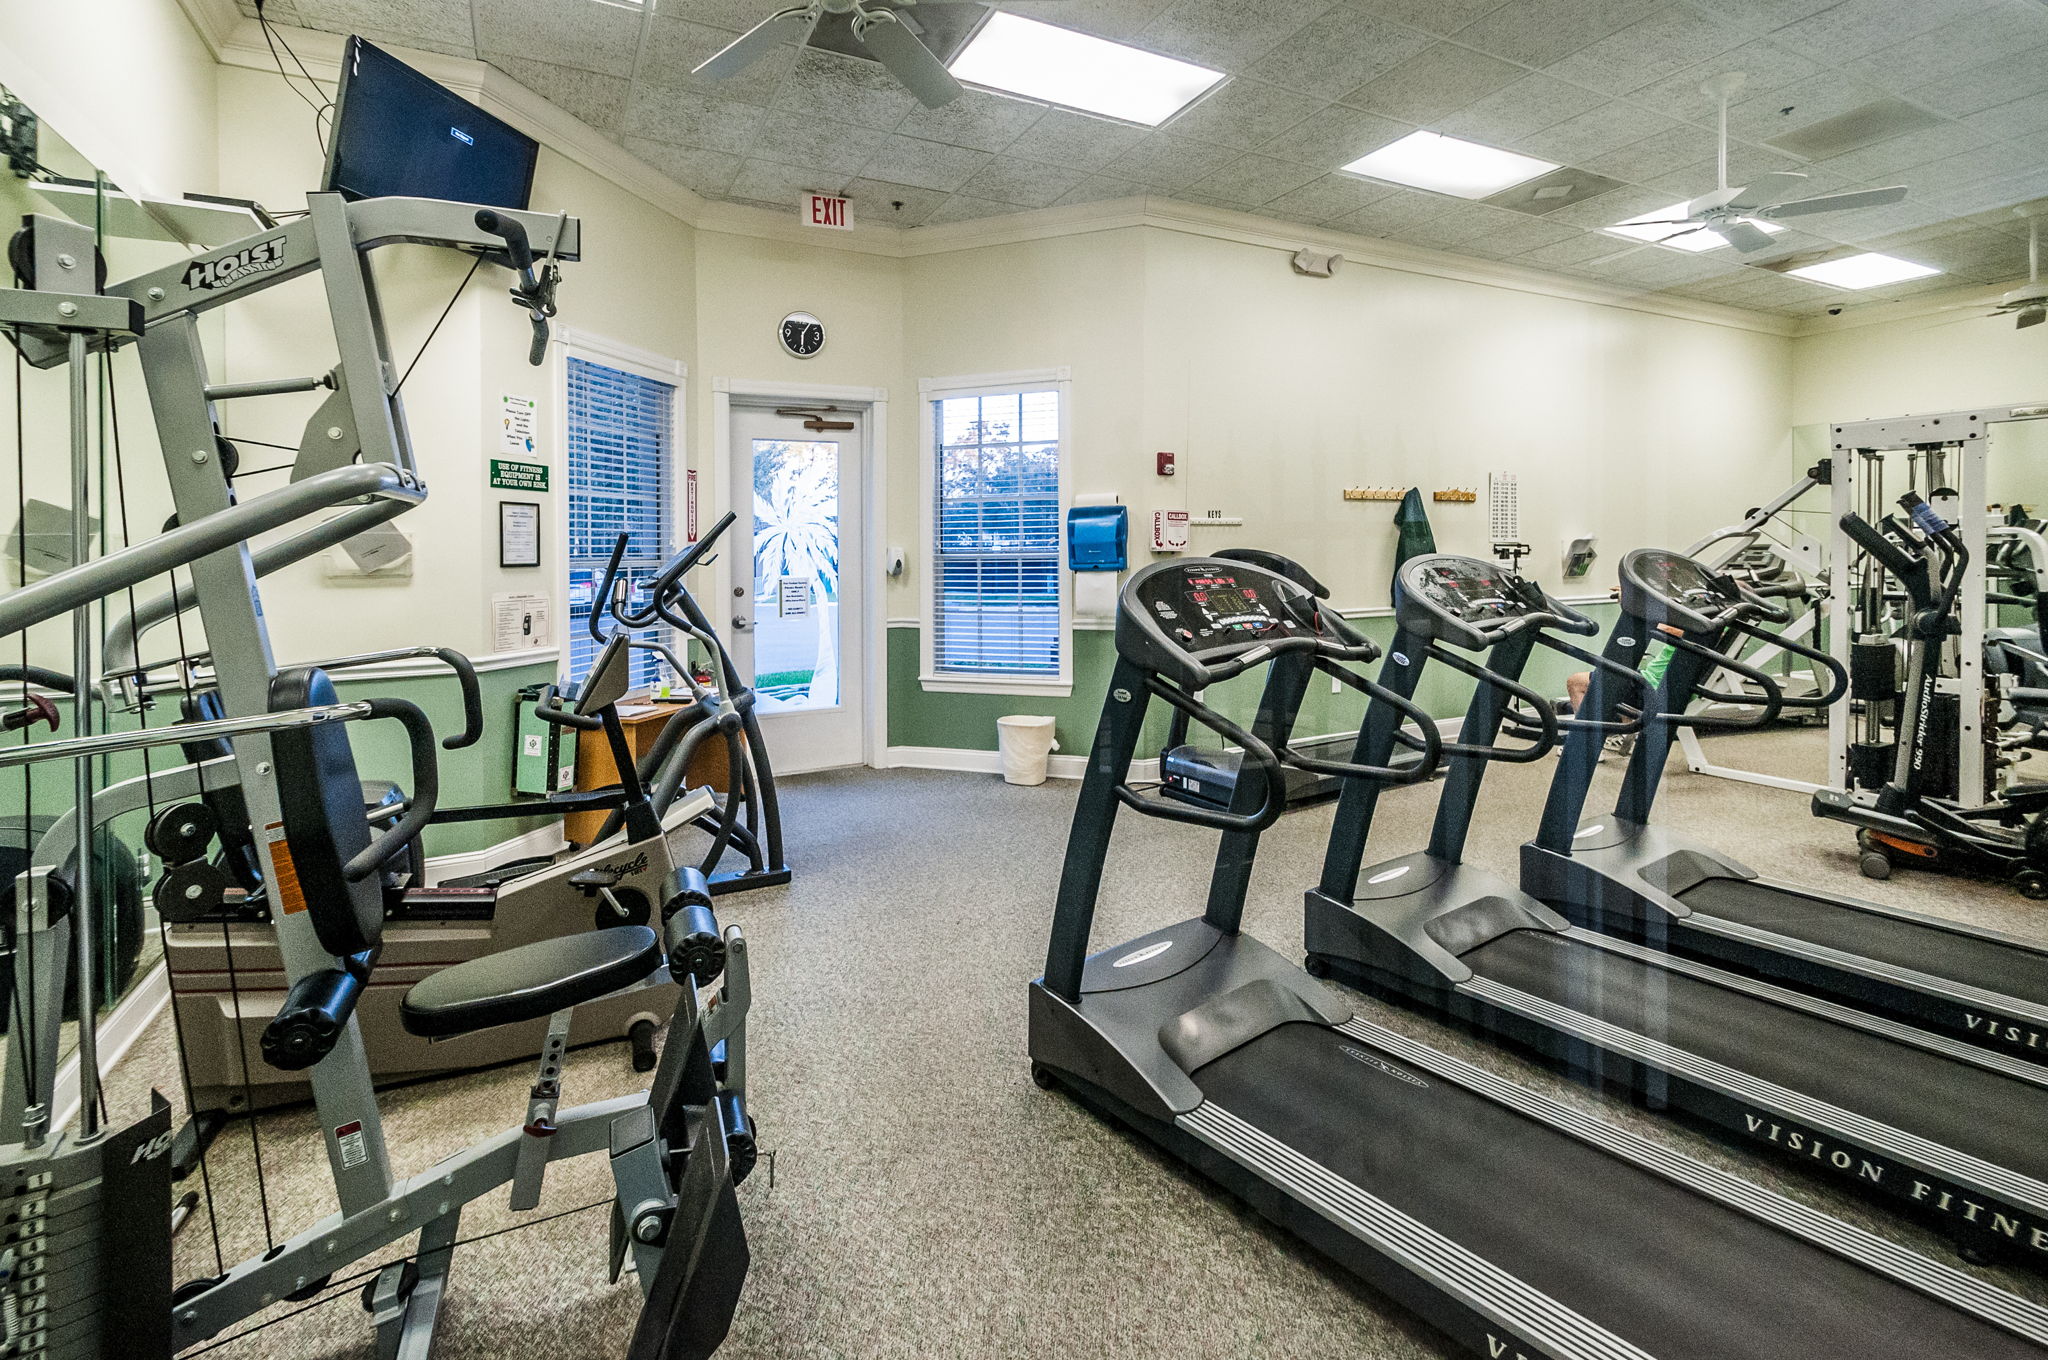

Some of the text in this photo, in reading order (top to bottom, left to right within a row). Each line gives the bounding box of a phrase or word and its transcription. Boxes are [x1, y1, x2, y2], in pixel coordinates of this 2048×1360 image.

[812, 196, 846, 226] EXIT
[189, 235, 287, 290] HOIST
[784, 328, 792, 338] 9
[813, 331, 820, 341] 3
[799, 345, 806, 354] 6
[497, 462, 510, 470] USE
[520, 465, 543, 474] FITNESS
[500, 470, 541, 481] EQUIPMENT IS
[492, 477, 501, 485] AT
[501, 478, 518, 486] YOUR
[518, 479, 532, 487] OWN
[1169, 512, 1188, 520] CALLBOX
[1207, 510, 1222, 518] KEYS
[1913, 673, 1933, 770] AudioStrider 990
[1745, 1113, 1884, 1182] VISION
[29, 1203, 37, 1214] 2
[28, 1221, 37, 1233] 3
